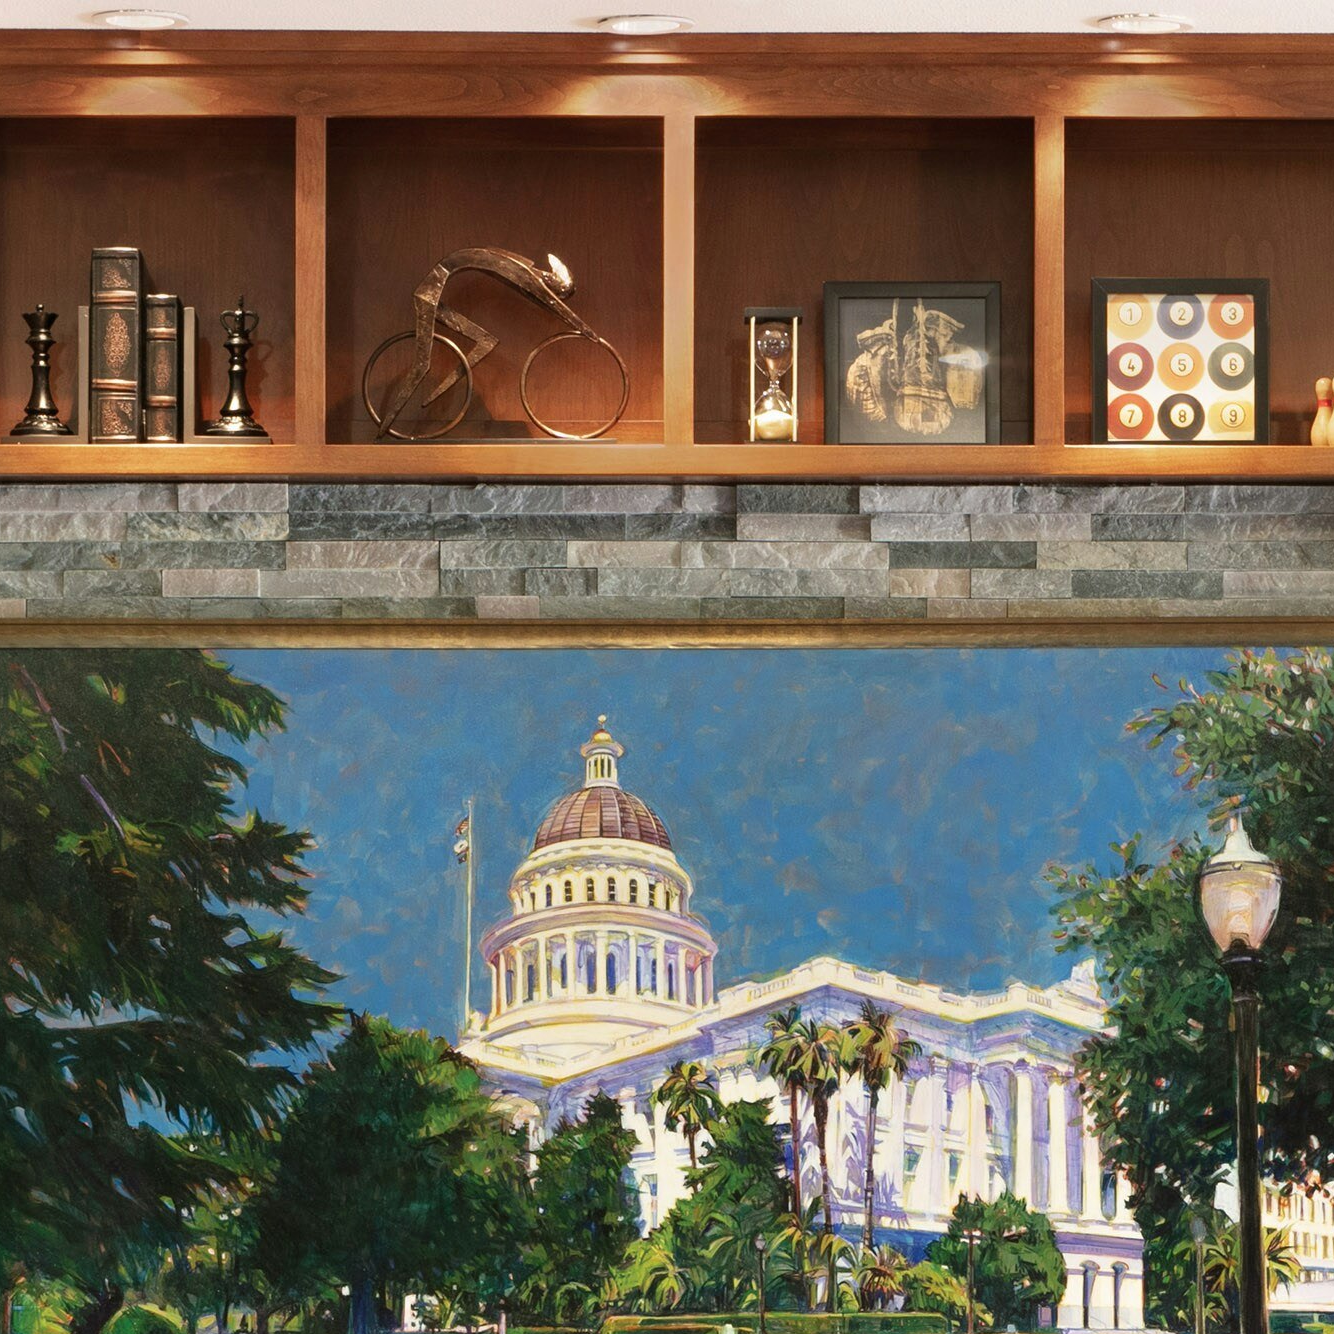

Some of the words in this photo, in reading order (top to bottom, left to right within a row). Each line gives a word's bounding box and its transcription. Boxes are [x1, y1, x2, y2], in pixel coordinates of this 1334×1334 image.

[1126, 308, 1133, 321] 1
[1177, 307, 1186, 321] 2
[1228, 307, 1237, 321] 3
[1127, 359, 1136, 372] 4
[1177, 359, 1187, 372] 5
[1229, 358, 1238, 371] 6
[1127, 410, 1135, 424] 7
[1178, 409, 1187, 423] 8
[1229, 409, 1238, 423] 9
